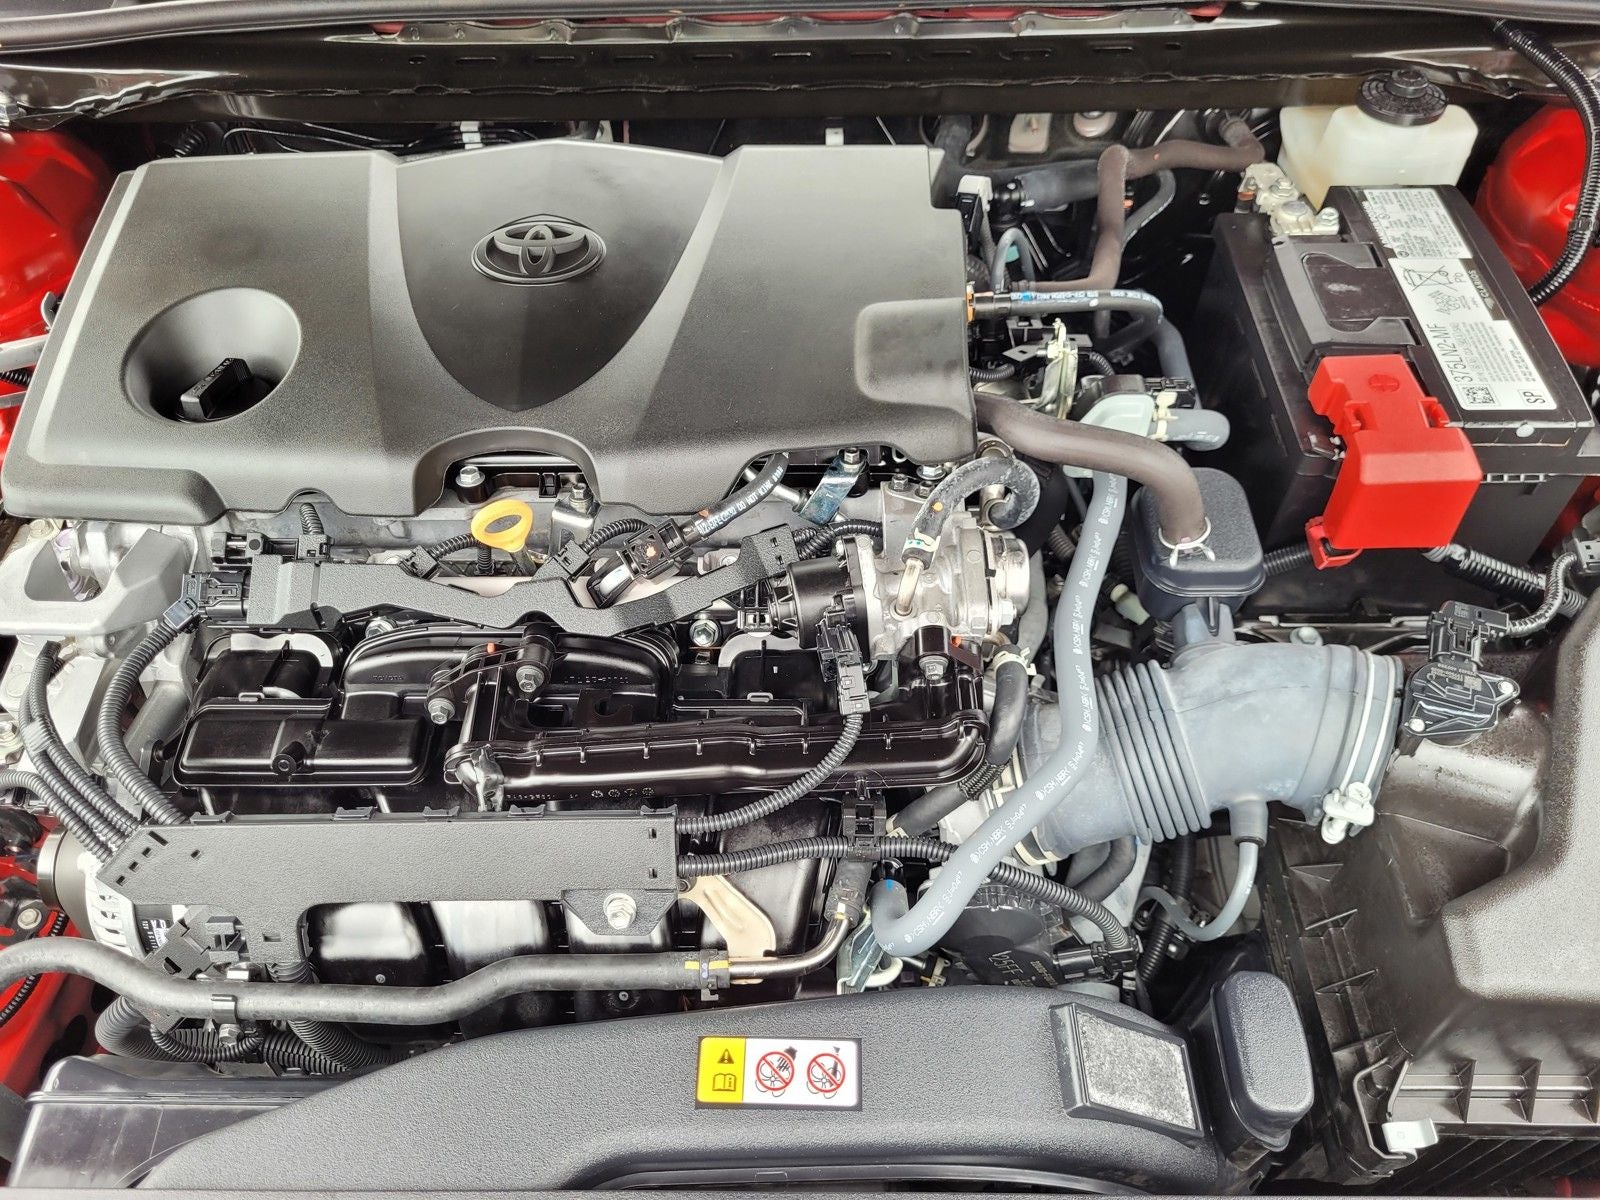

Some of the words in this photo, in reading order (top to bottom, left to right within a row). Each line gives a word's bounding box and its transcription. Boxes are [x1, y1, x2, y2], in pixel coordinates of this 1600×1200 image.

[1426, 323, 1474, 383] 375LN2-MF
[1523, 391, 1546, 404] SP
[746, 492, 759, 505] NOT
